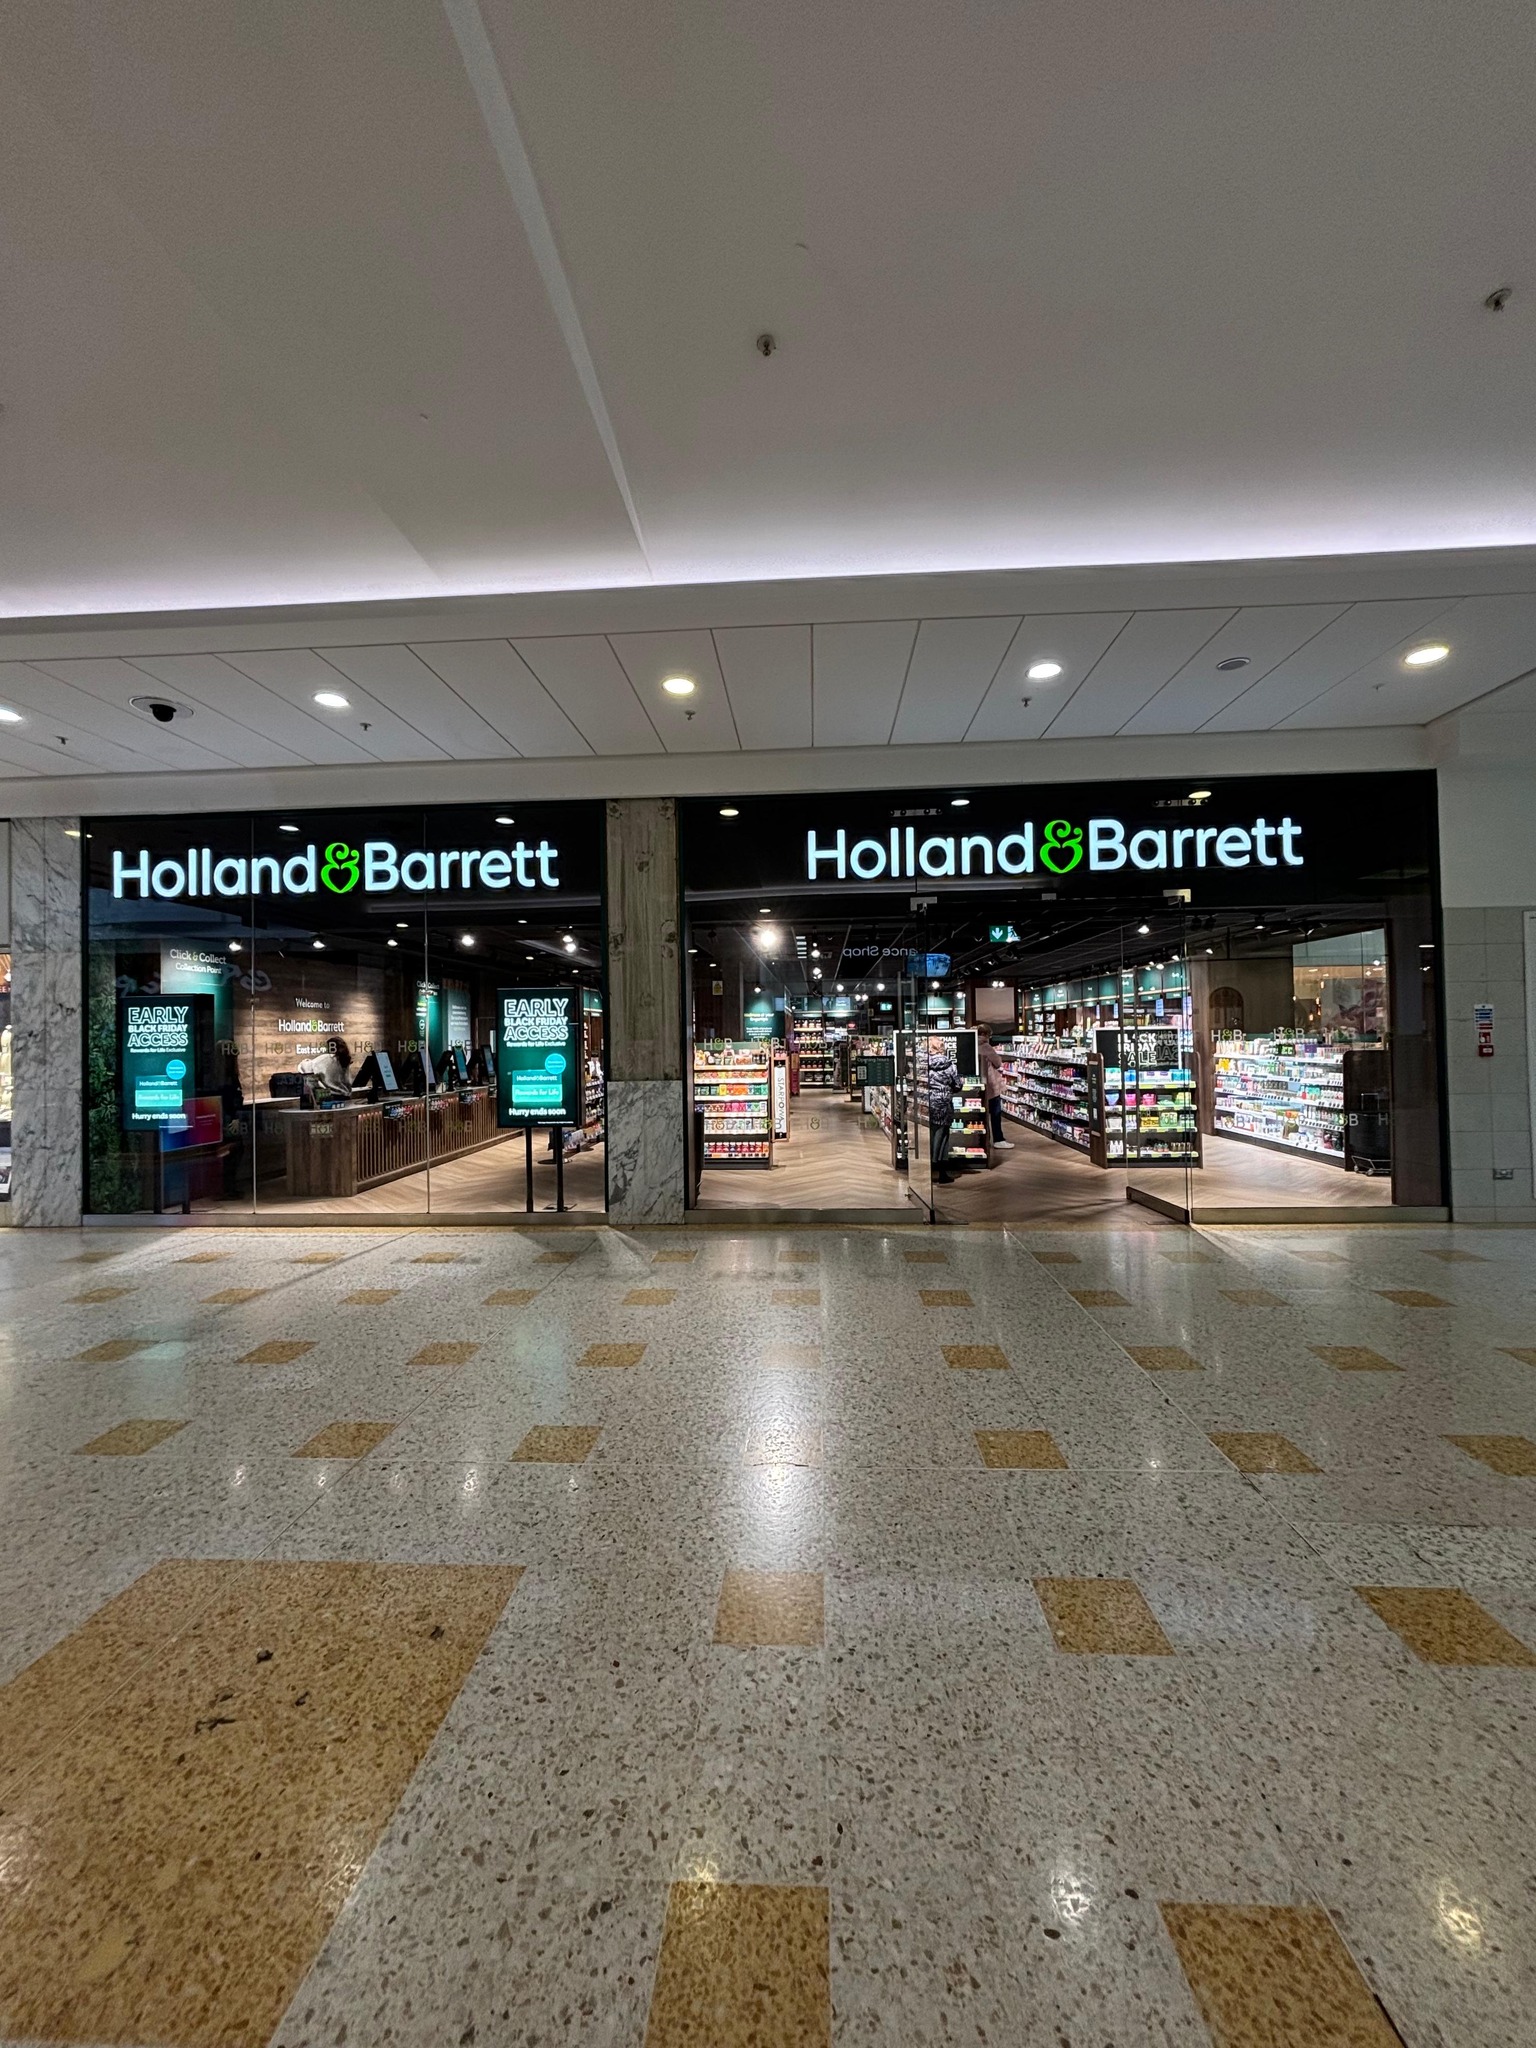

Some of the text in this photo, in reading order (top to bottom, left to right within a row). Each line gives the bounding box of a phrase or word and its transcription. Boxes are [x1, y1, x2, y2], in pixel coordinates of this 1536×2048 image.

[169, 949, 227, 965] Click & Collect
[175, 962, 222, 974] Collection Point
[295, 998, 323, 1009] Welcome
[503, 998, 569, 1017] EARLY
[128, 1006, 189, 1024] EARLY
[504, 1017, 568, 1026] BLACK FRIDAY
[128, 1024, 188, 1033] BLACK FRIDAY
[503, 1025, 569, 1041] ACCESS
[127, 1032, 189, 1048] ACCESS
[131, 1113, 152, 1121] Hurry
[508, 1108, 530, 1117] Hurry
[530, 1107, 547, 1115] ends
